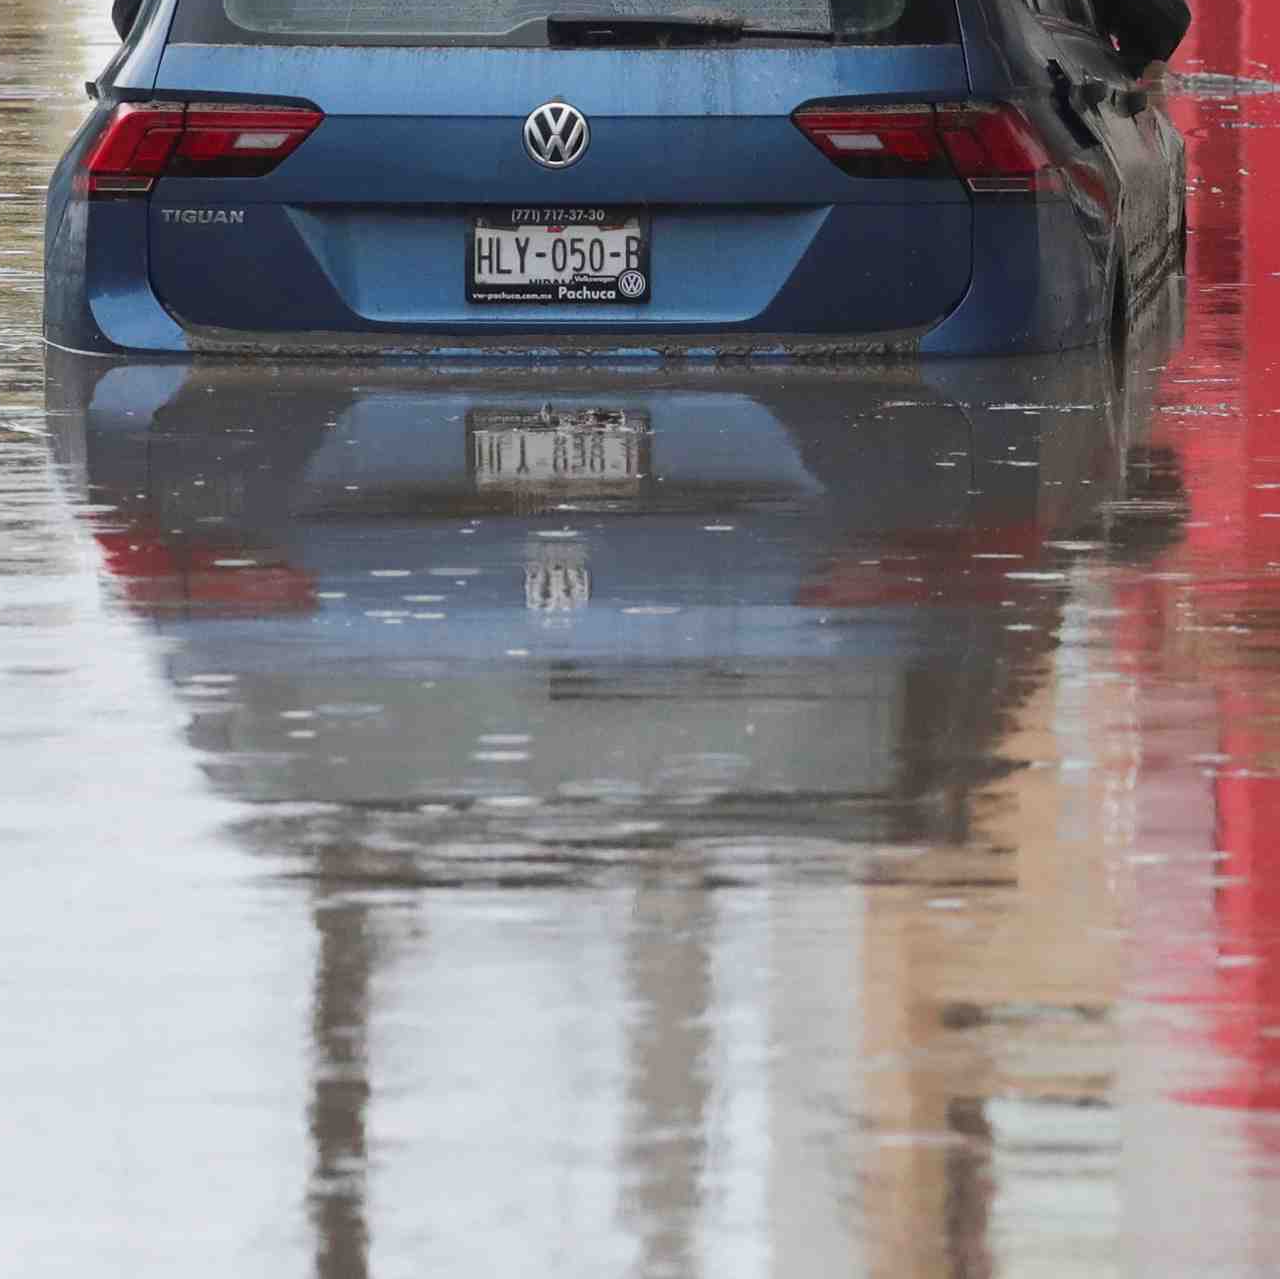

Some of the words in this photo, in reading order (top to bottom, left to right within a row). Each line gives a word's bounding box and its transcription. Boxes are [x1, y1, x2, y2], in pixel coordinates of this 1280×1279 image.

[161, 208, 245, 224] TIGUAN
[511, 209, 540, 223] (771)
[543, 209, 605, 221] 717-37-30
[476, 235, 641, 275] HLY-050-B
[558, 286, 616, 300] Pachuca
